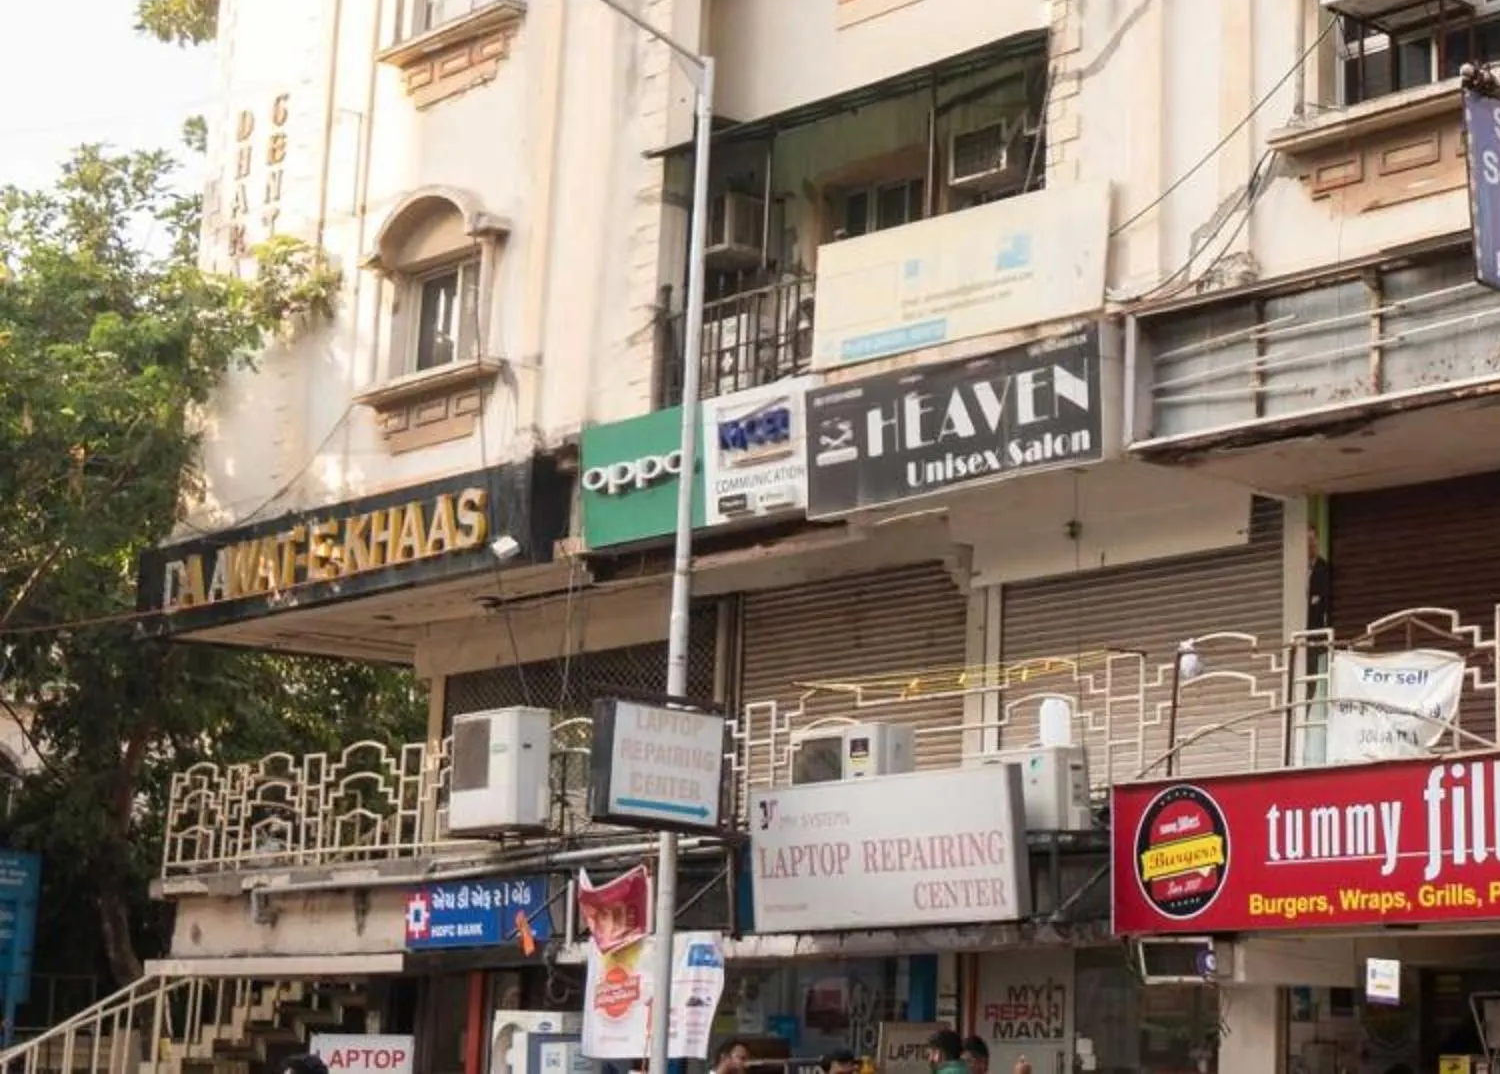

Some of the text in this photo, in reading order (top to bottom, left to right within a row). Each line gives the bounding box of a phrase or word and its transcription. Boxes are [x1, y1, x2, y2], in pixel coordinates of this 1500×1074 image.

[867, 357, 1090, 458] HEAVEN
[907, 429, 1091, 488] Unisex Salon
[1362, 667, 1429, 686] For sell
[636, 707, 704, 736] LAPTOP
[620, 737, 716, 772] REPAIRING
[630, 771, 702, 800] CENTER
[759, 829, 1005, 879] LAPTOP REPAIRING
[1265, 800, 1402, 876] tummy
[1149, 844, 1219, 870] Burgers
[913, 877, 1006, 911] CENTER
[1248, 890, 1335, 918] Burgers,
[1340, 886, 1412, 914] Wraps,
[1418, 882, 1483, 909] Grills,
[1007, 983, 1046, 1003] MY
[993, 1021, 1051, 1039] MAN
